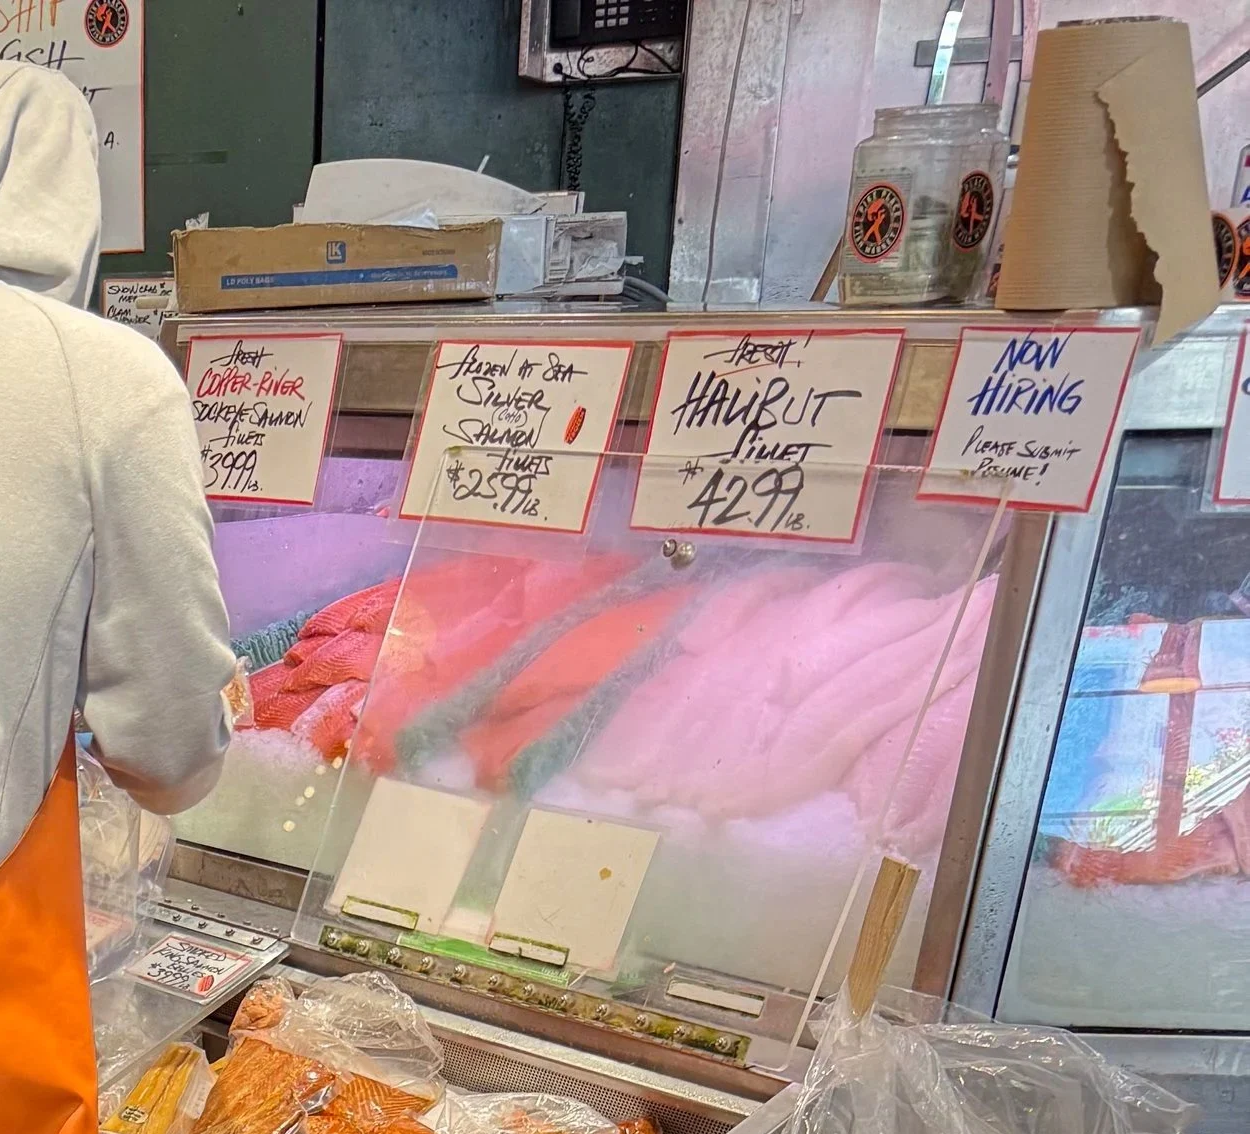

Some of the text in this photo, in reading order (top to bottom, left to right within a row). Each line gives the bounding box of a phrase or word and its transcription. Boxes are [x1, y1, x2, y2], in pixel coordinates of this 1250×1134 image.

[518, 358, 542, 381] AT
[542, 352, 588, 383] SEA
[992, 328, 1077, 375] NOW
[456, 376, 552, 413] SILVER
[967, 369, 1085, 416] HIRING
[443, 414, 548, 449] SALMON
[961, 425, 1082, 461] PLEASE SUBMIT
